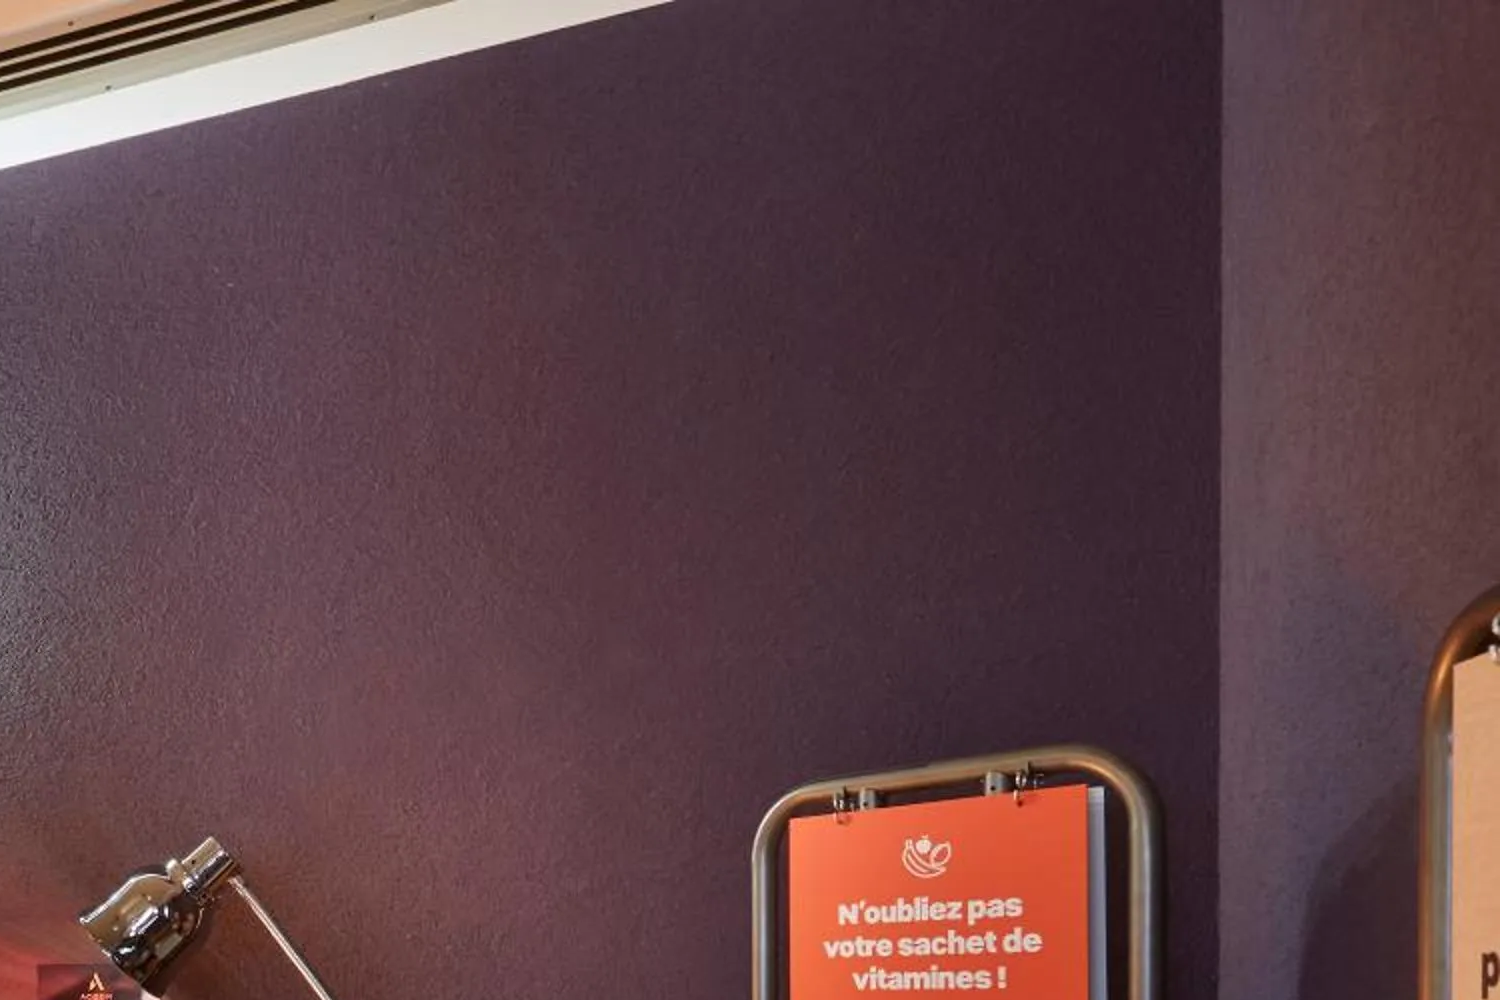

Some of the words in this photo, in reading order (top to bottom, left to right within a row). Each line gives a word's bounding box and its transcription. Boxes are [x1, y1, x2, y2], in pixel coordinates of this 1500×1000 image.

[838, 897, 962, 925] N'oubliez
[968, 897, 1023, 926] pas
[823, 935, 894, 959] votre
[897, 929, 997, 957] sachet
[1002, 926, 1043, 954] de
[852, 964, 993, 991] vitamines
